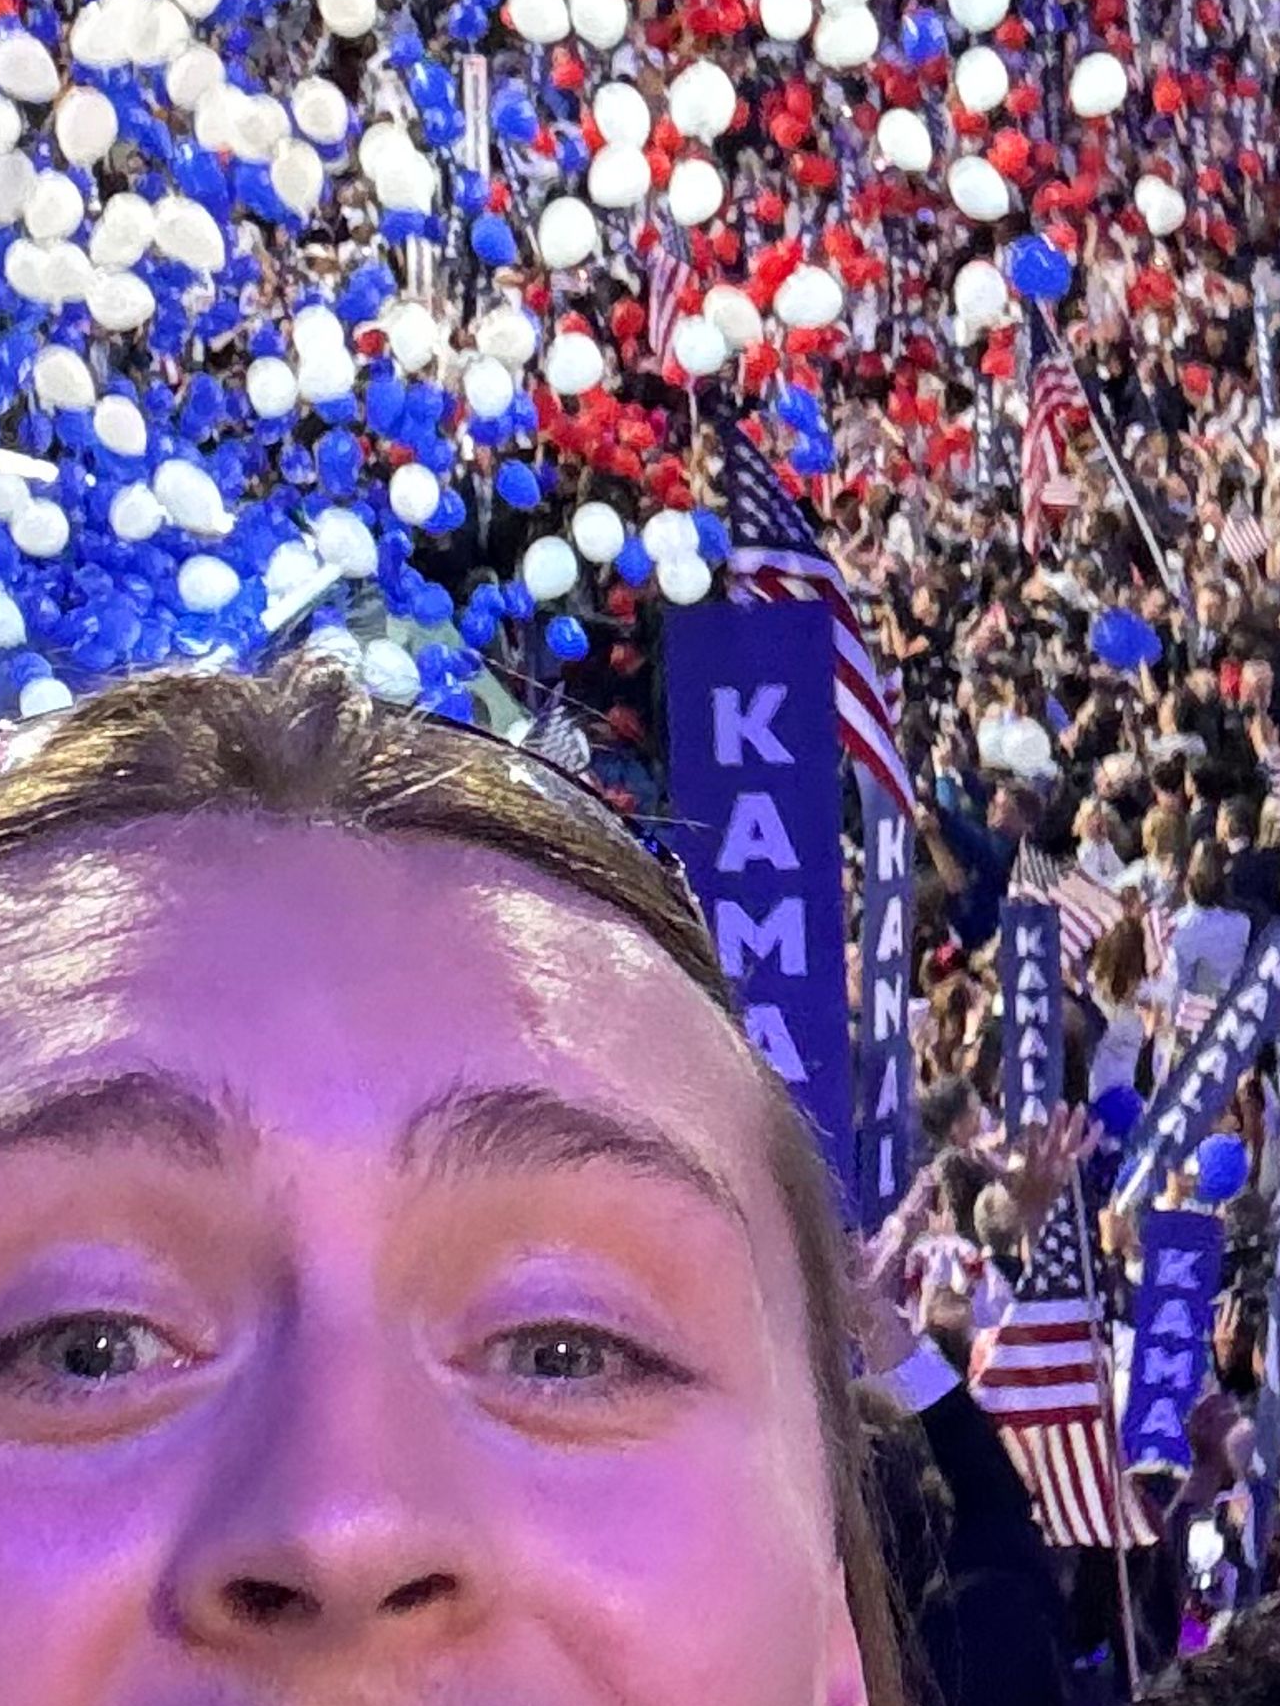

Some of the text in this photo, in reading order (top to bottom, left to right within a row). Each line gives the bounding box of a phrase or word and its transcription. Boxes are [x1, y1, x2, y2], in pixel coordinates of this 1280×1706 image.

[713, 682, 810, 1083] KAMA
[1014, 924, 1050, 1127] KAMALA
[1140, 1248, 1202, 1461] KAMA
